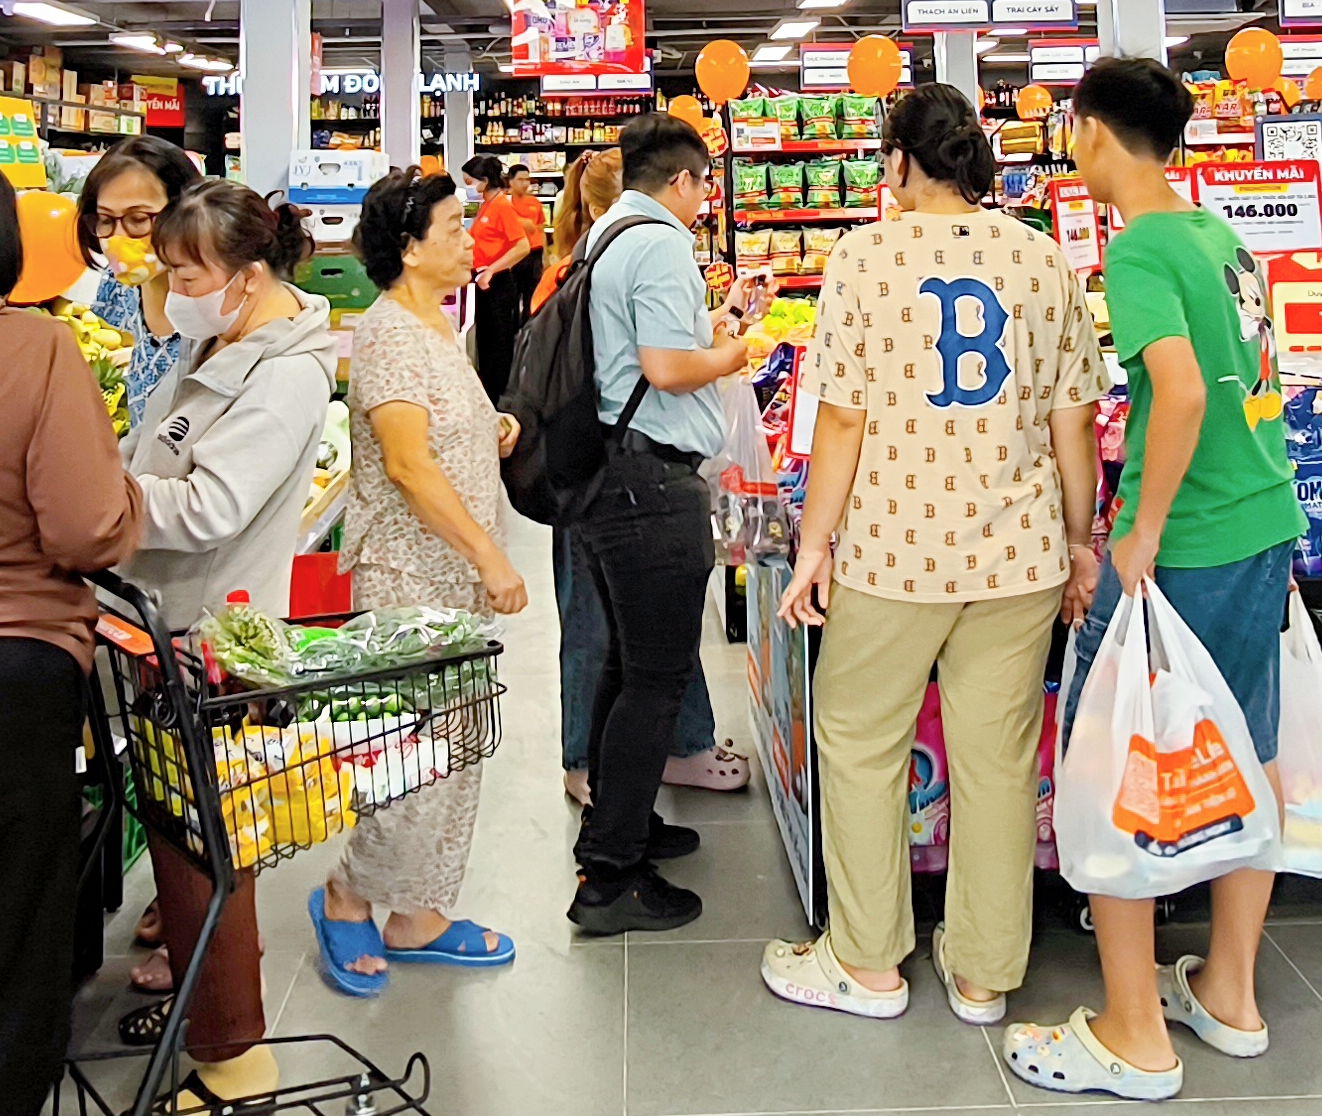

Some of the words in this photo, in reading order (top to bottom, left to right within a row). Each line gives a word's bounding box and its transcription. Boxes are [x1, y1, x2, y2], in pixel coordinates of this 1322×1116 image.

[419, 74, 479, 96] LẠNH
[1214, 165, 1274, 182] KHUYẾN
[1277, 165, 1304, 179] MÃI
[1223, 203, 1298, 218] 146.000
[918, 275, 1012, 408] B
